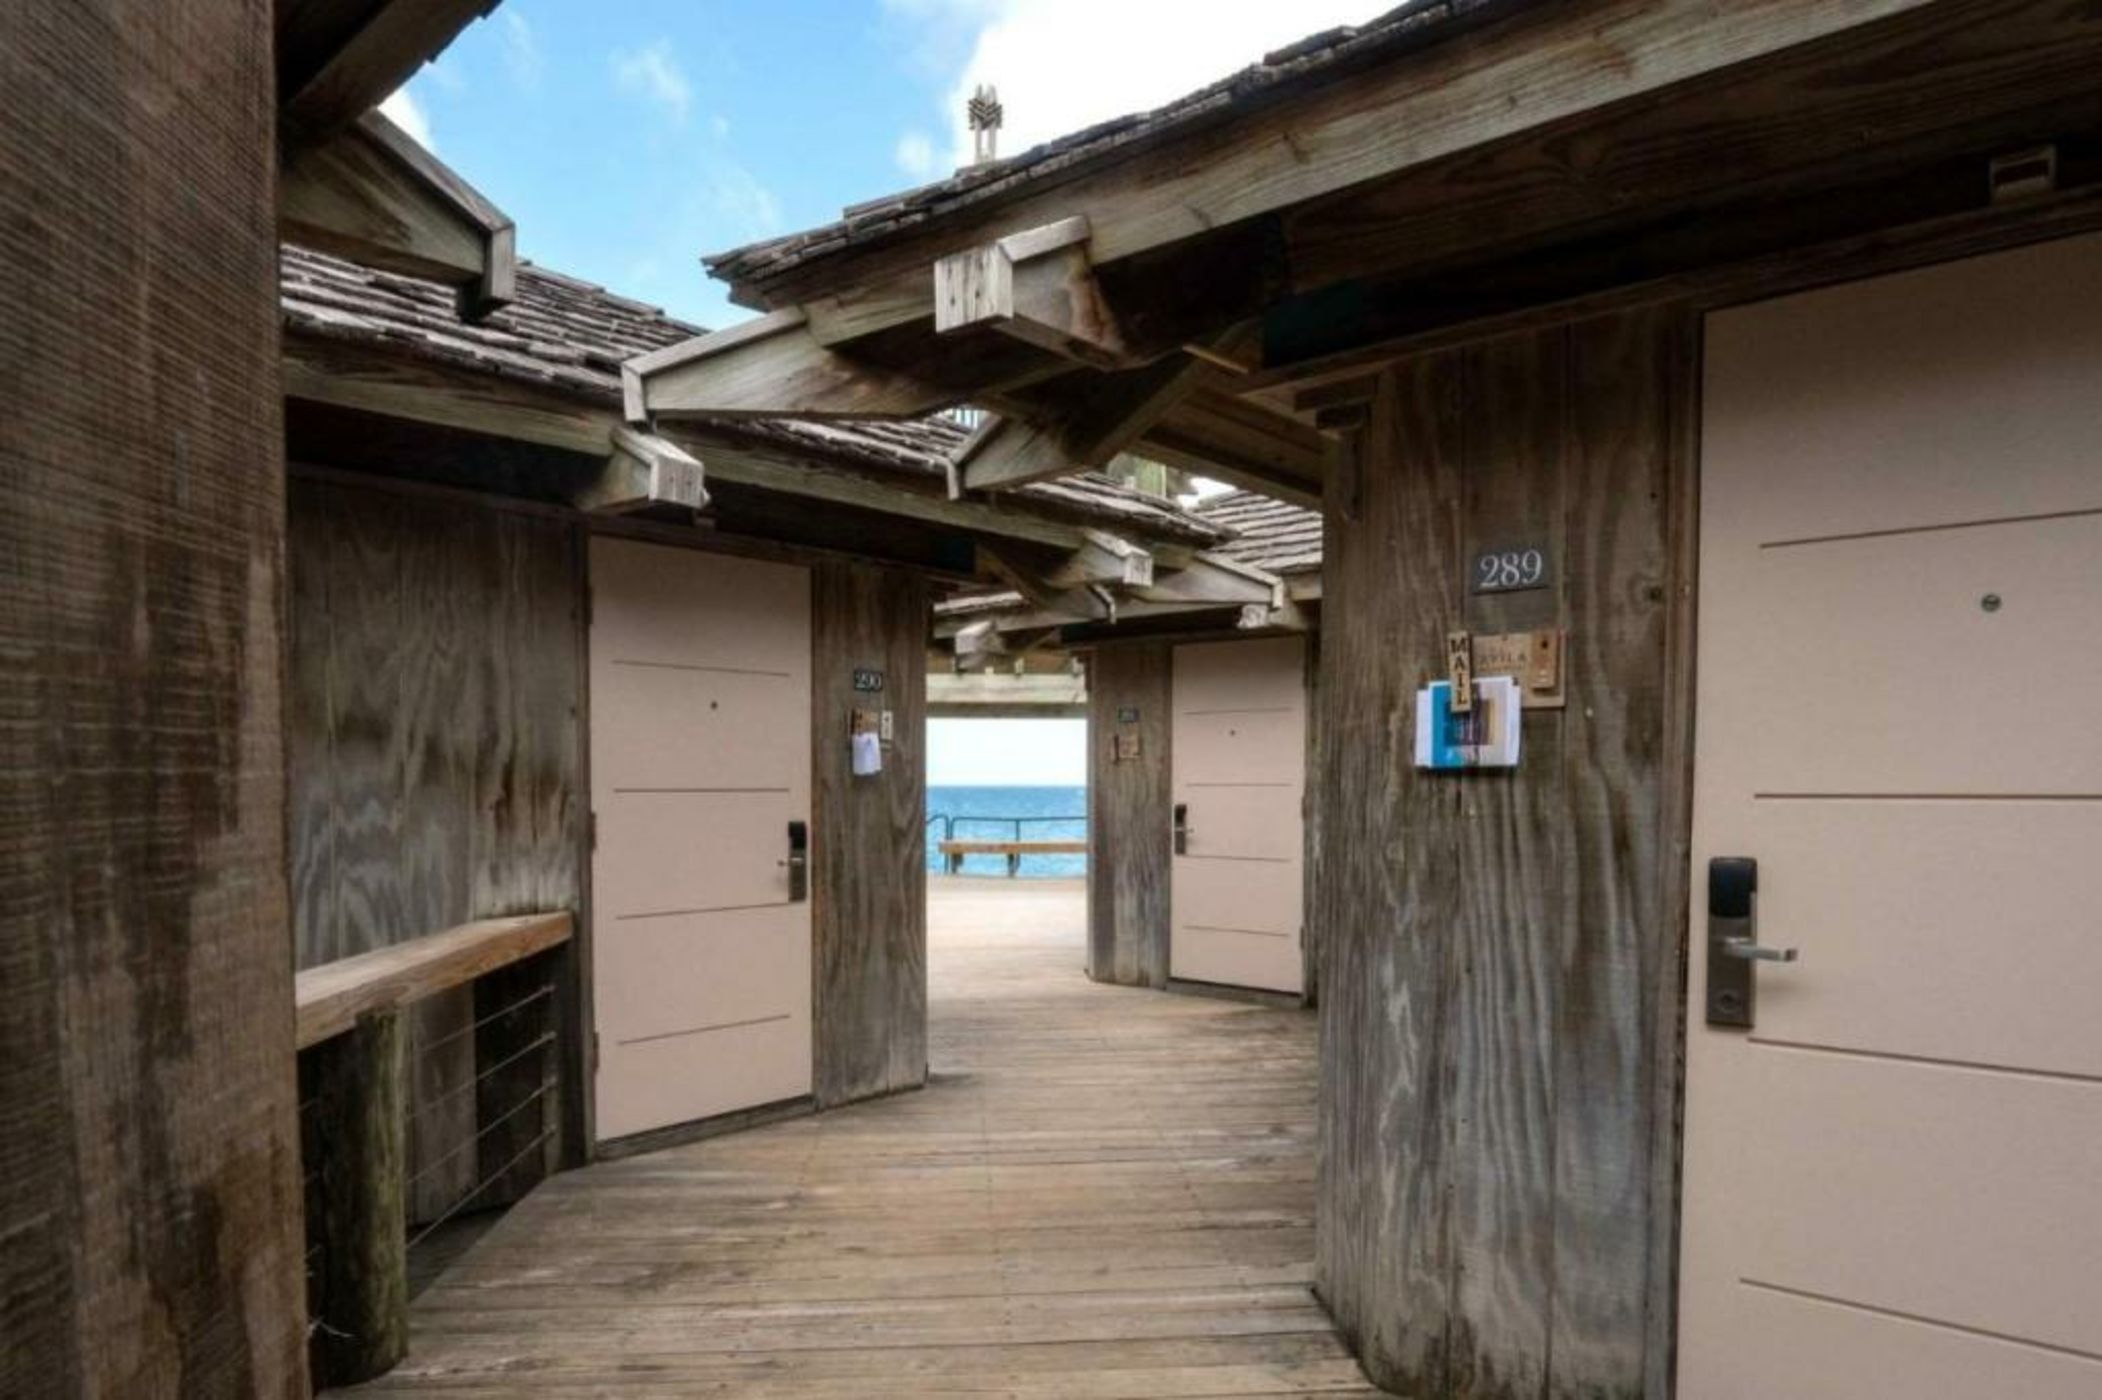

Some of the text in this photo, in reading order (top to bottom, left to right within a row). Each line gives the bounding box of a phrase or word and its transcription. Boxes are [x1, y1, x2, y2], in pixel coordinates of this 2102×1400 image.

[1480, 550, 1542, 587] 289
[855, 671, 882, 690] 290
[1450, 638, 1469, 705] MAIL
